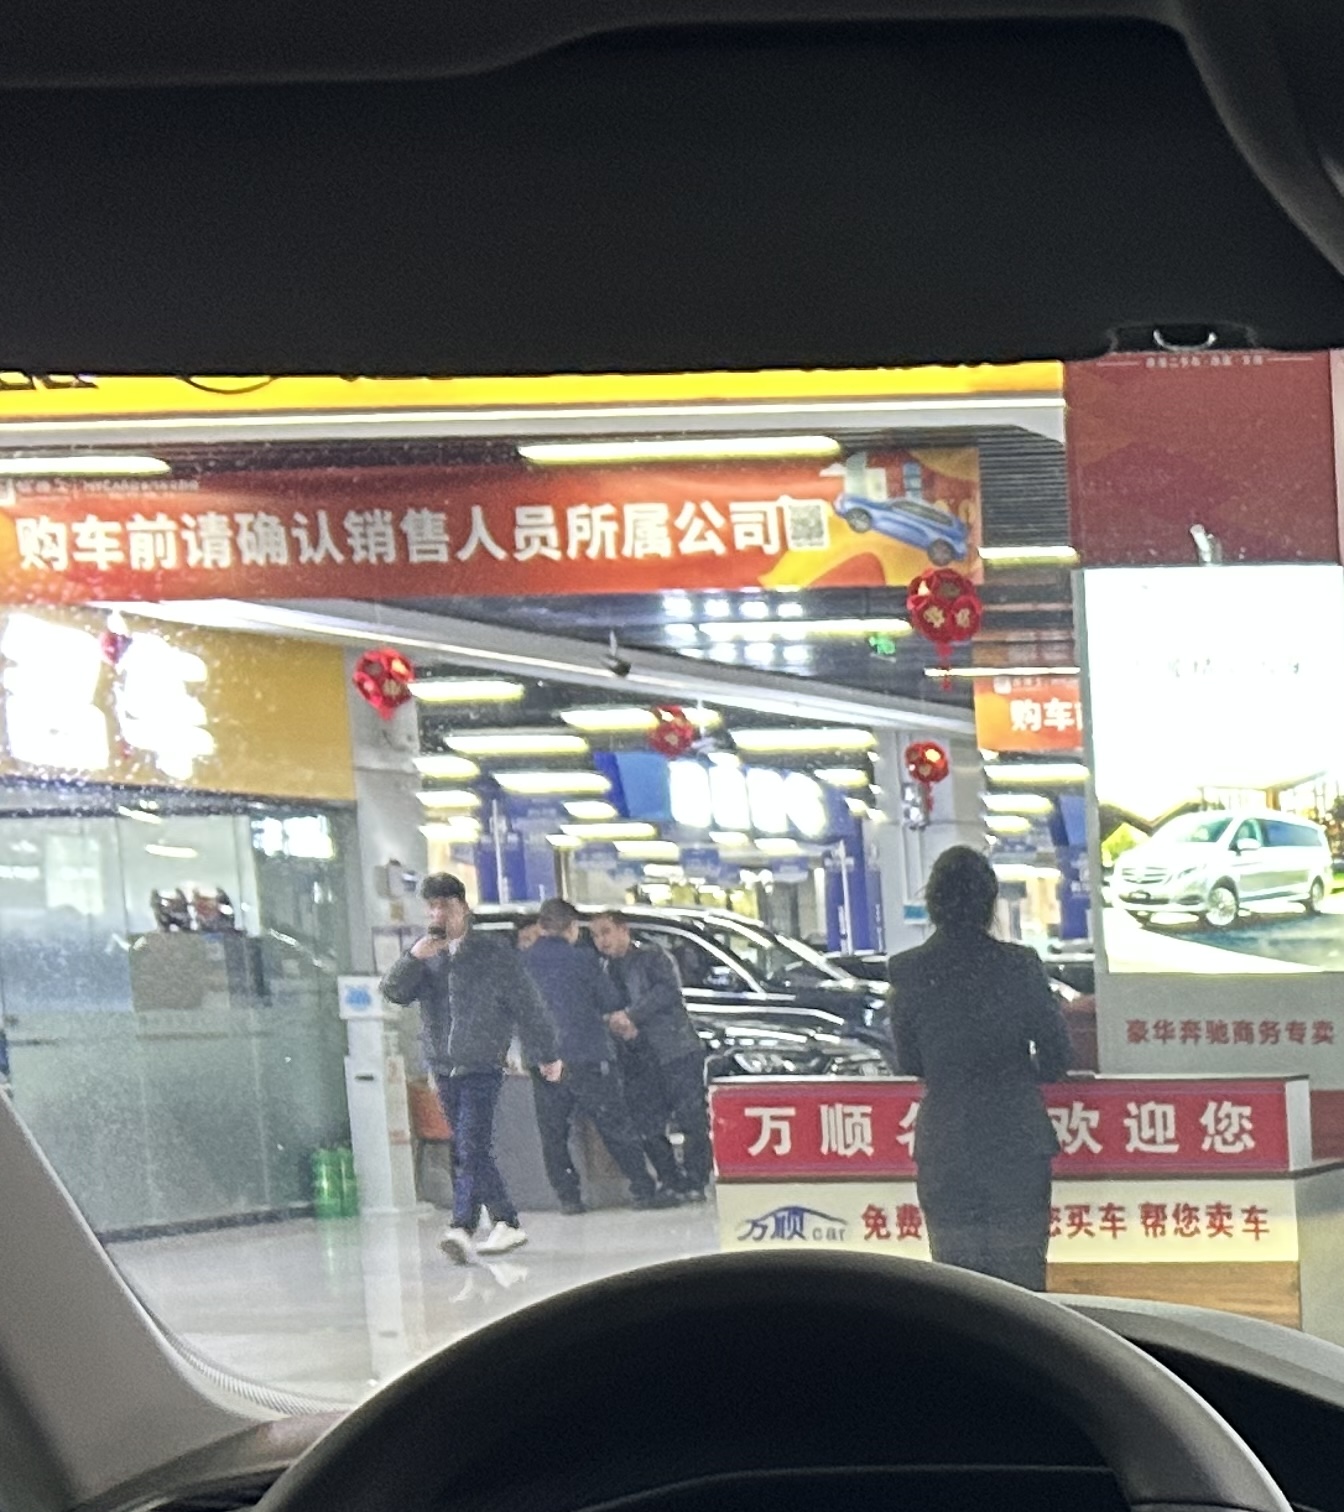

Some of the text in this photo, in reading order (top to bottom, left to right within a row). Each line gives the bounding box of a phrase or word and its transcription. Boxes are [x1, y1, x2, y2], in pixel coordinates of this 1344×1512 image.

[15, 501, 780, 571] 购车前请确认销售人员所属公司
[1010, 697, 1083, 733] 购车
[1126, 1018, 1336, 1046] 豪华奔驰商务专卖
[745, 1101, 1257, 1156] 万顺欢迎您
[812, 1225, 848, 1242] car
[1140, 1202, 1270, 1241] 帮您卖车
